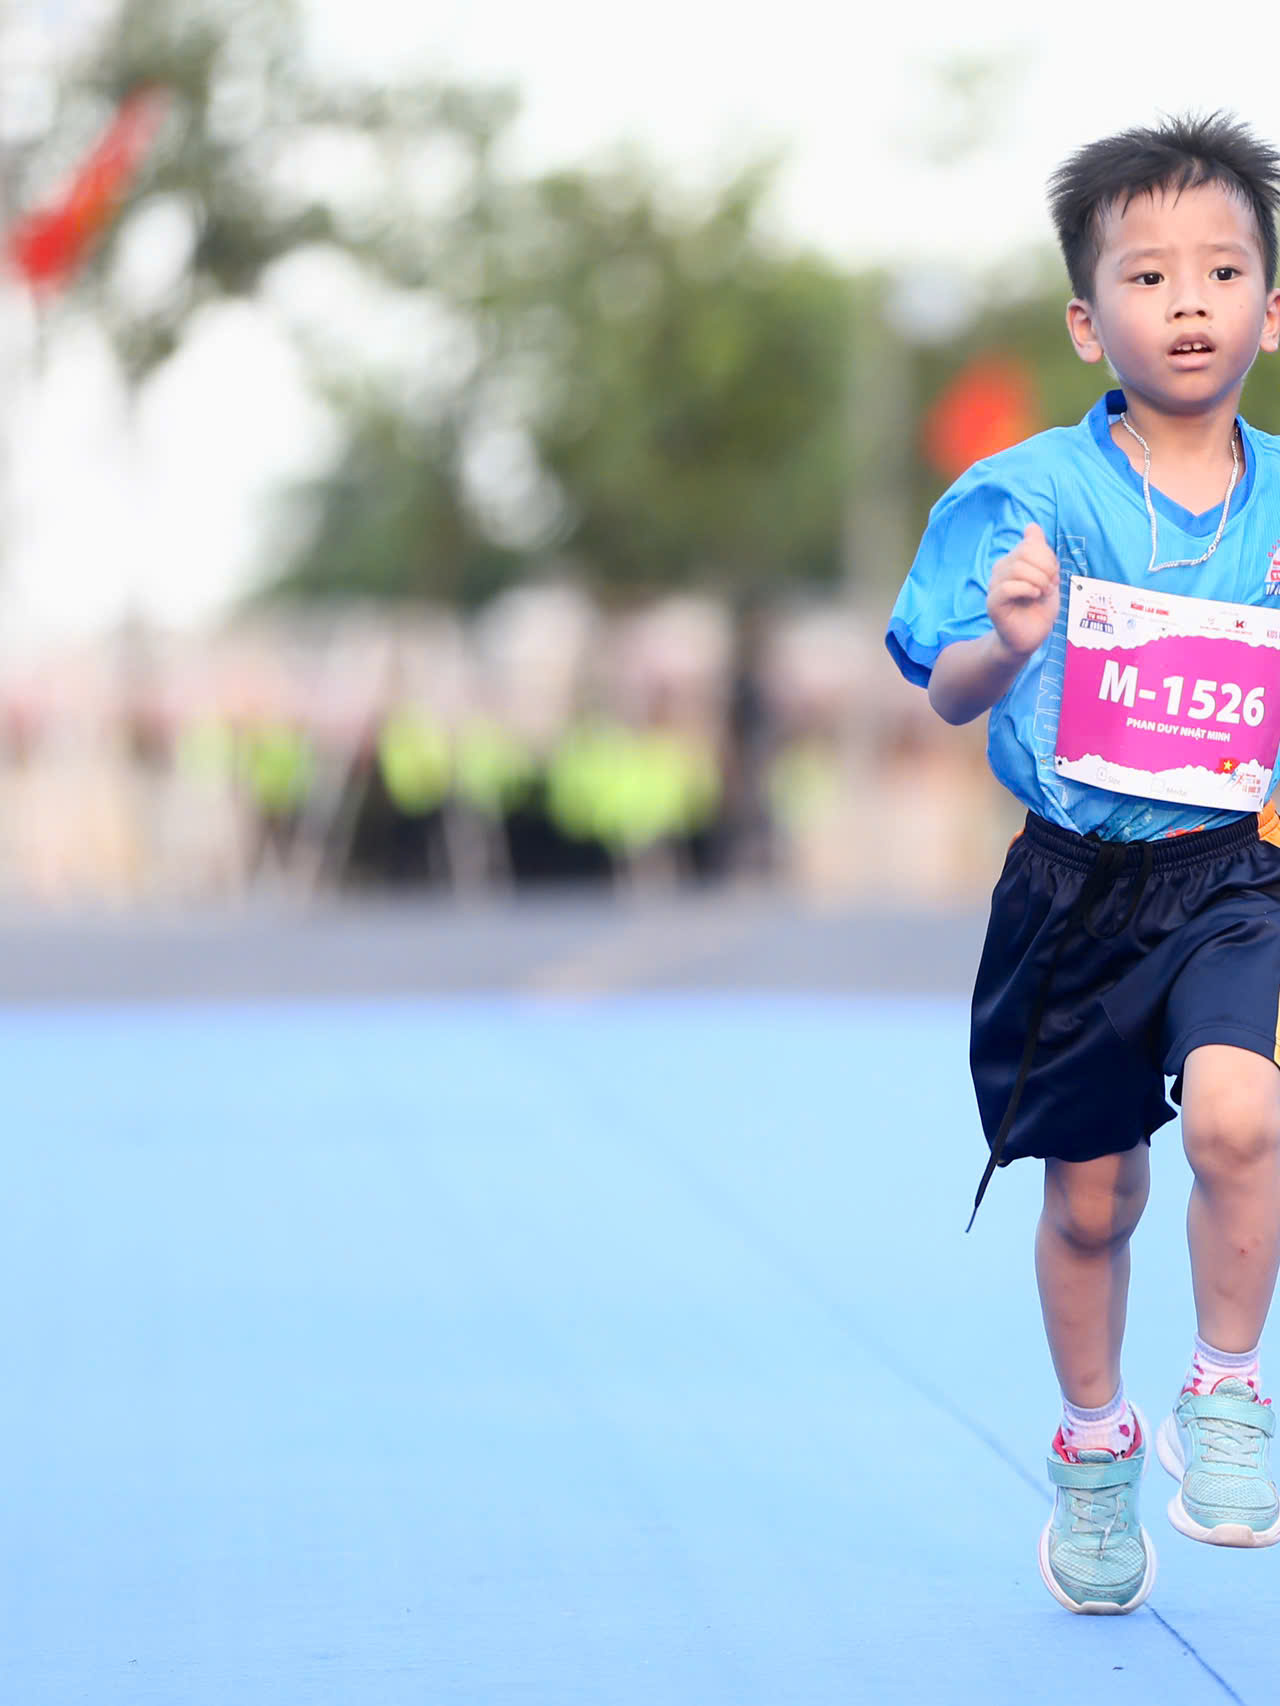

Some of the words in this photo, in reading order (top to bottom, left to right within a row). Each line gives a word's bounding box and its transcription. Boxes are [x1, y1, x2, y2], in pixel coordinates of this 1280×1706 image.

[1098, 659, 1266, 728] M-1526
[1126, 717, 1156, 731] PHAN
[1156, 722, 1179, 735] DUY
[1207, 730, 1232, 743] MINH
